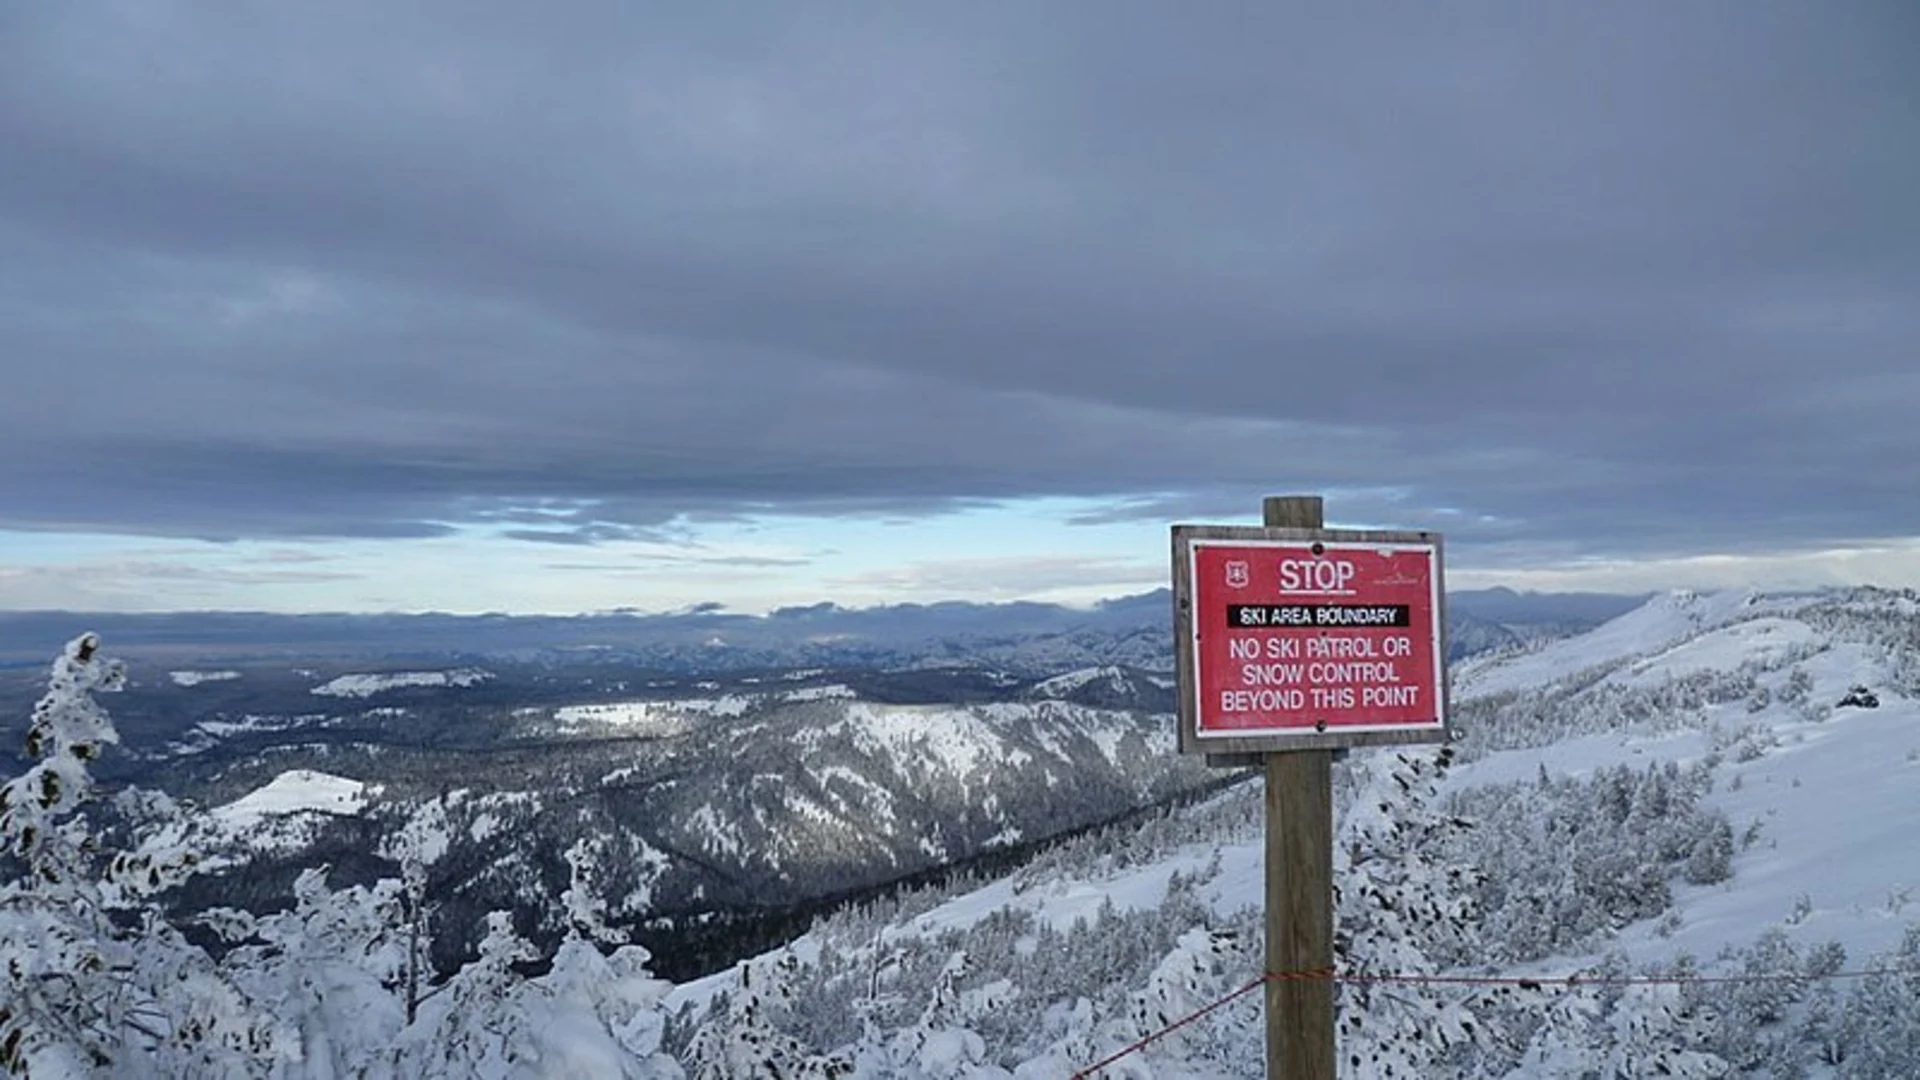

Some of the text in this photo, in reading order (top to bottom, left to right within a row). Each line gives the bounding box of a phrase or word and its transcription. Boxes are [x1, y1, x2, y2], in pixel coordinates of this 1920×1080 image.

[1280, 560, 1355, 589] STOP
[1240, 608, 1397, 624] SKI AREA BOUNDARY
[1230, 637, 1411, 658] NO SKI PATROL OR
[1242, 663, 1400, 685] SNOW CONTROL
[1221, 686, 1419, 711] BEYOND THIS POINT
